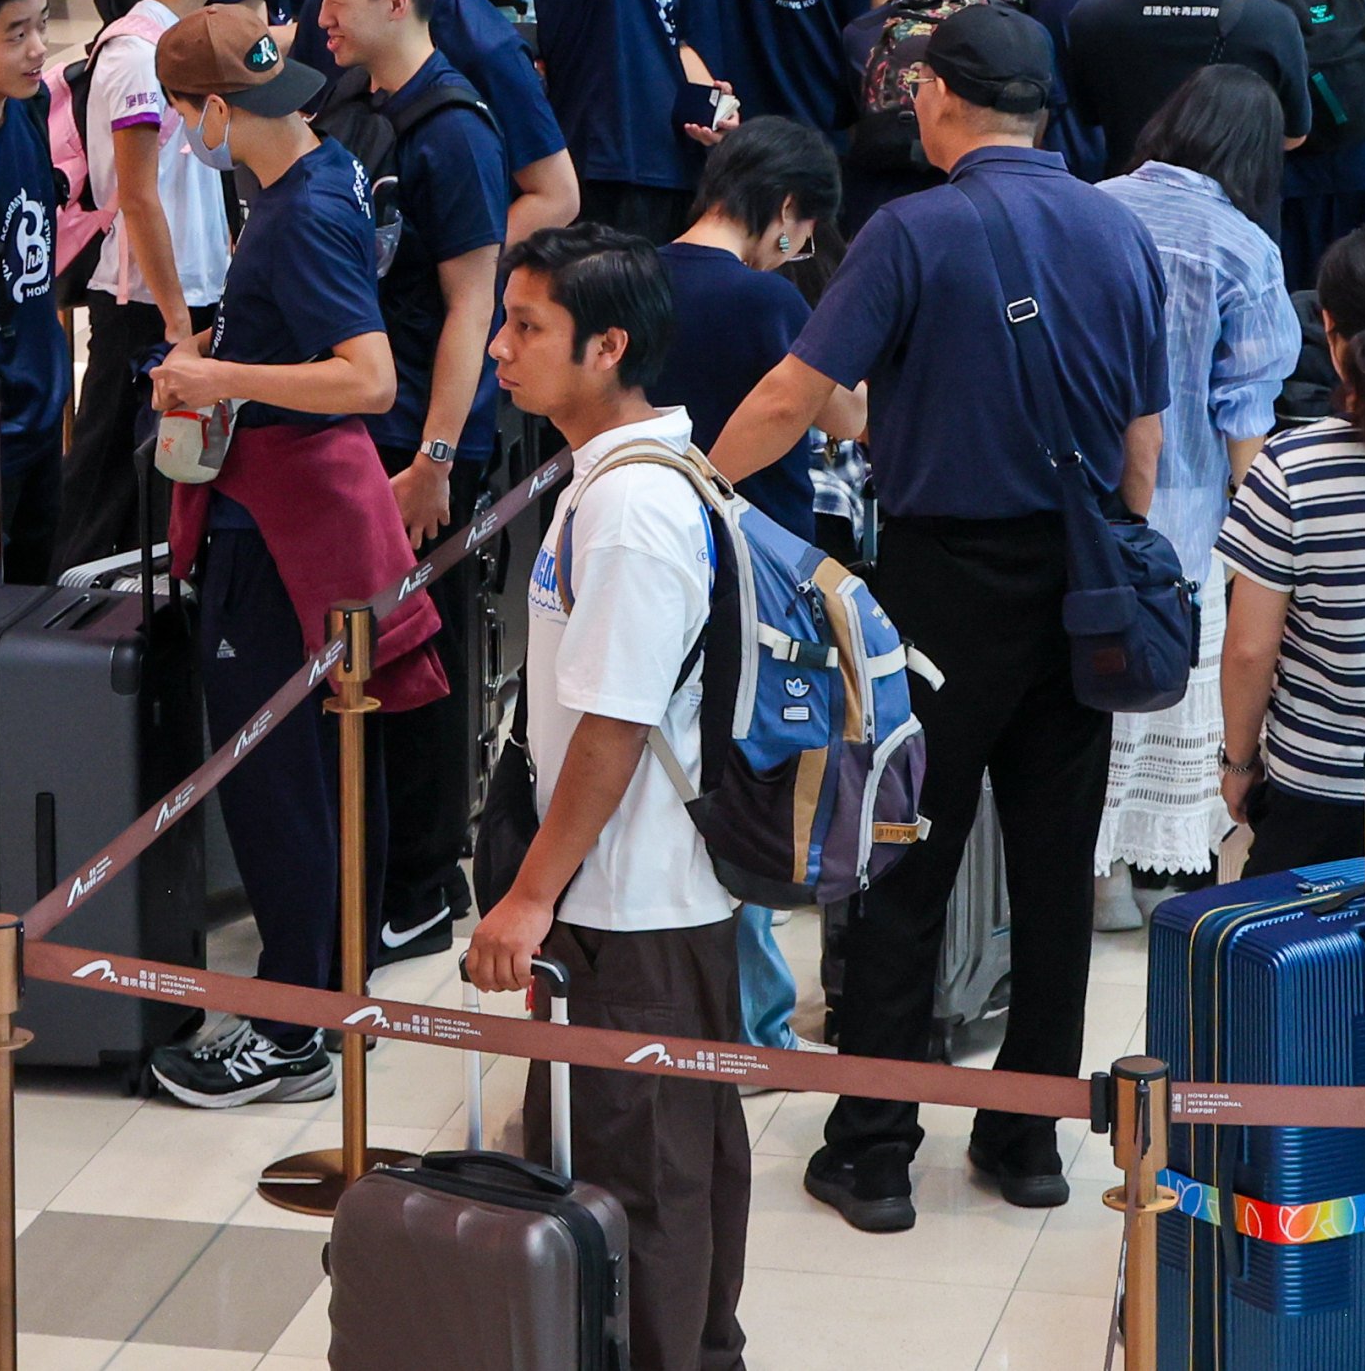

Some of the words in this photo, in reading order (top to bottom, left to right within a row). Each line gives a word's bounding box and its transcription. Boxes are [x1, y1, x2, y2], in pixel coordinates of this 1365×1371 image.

[160, 973, 177, 981] HONG
[160, 987, 186, 996] AIRPORT
[434, 1017, 452, 1025] HONG
[434, 1031, 461, 1040] AIRPORT
[719, 1066, 748, 1075] AIRPORT
[1187, 1101, 1243, 1109] INTERNATIONAL
[1187, 1107, 1218, 1115] AIRPORT
